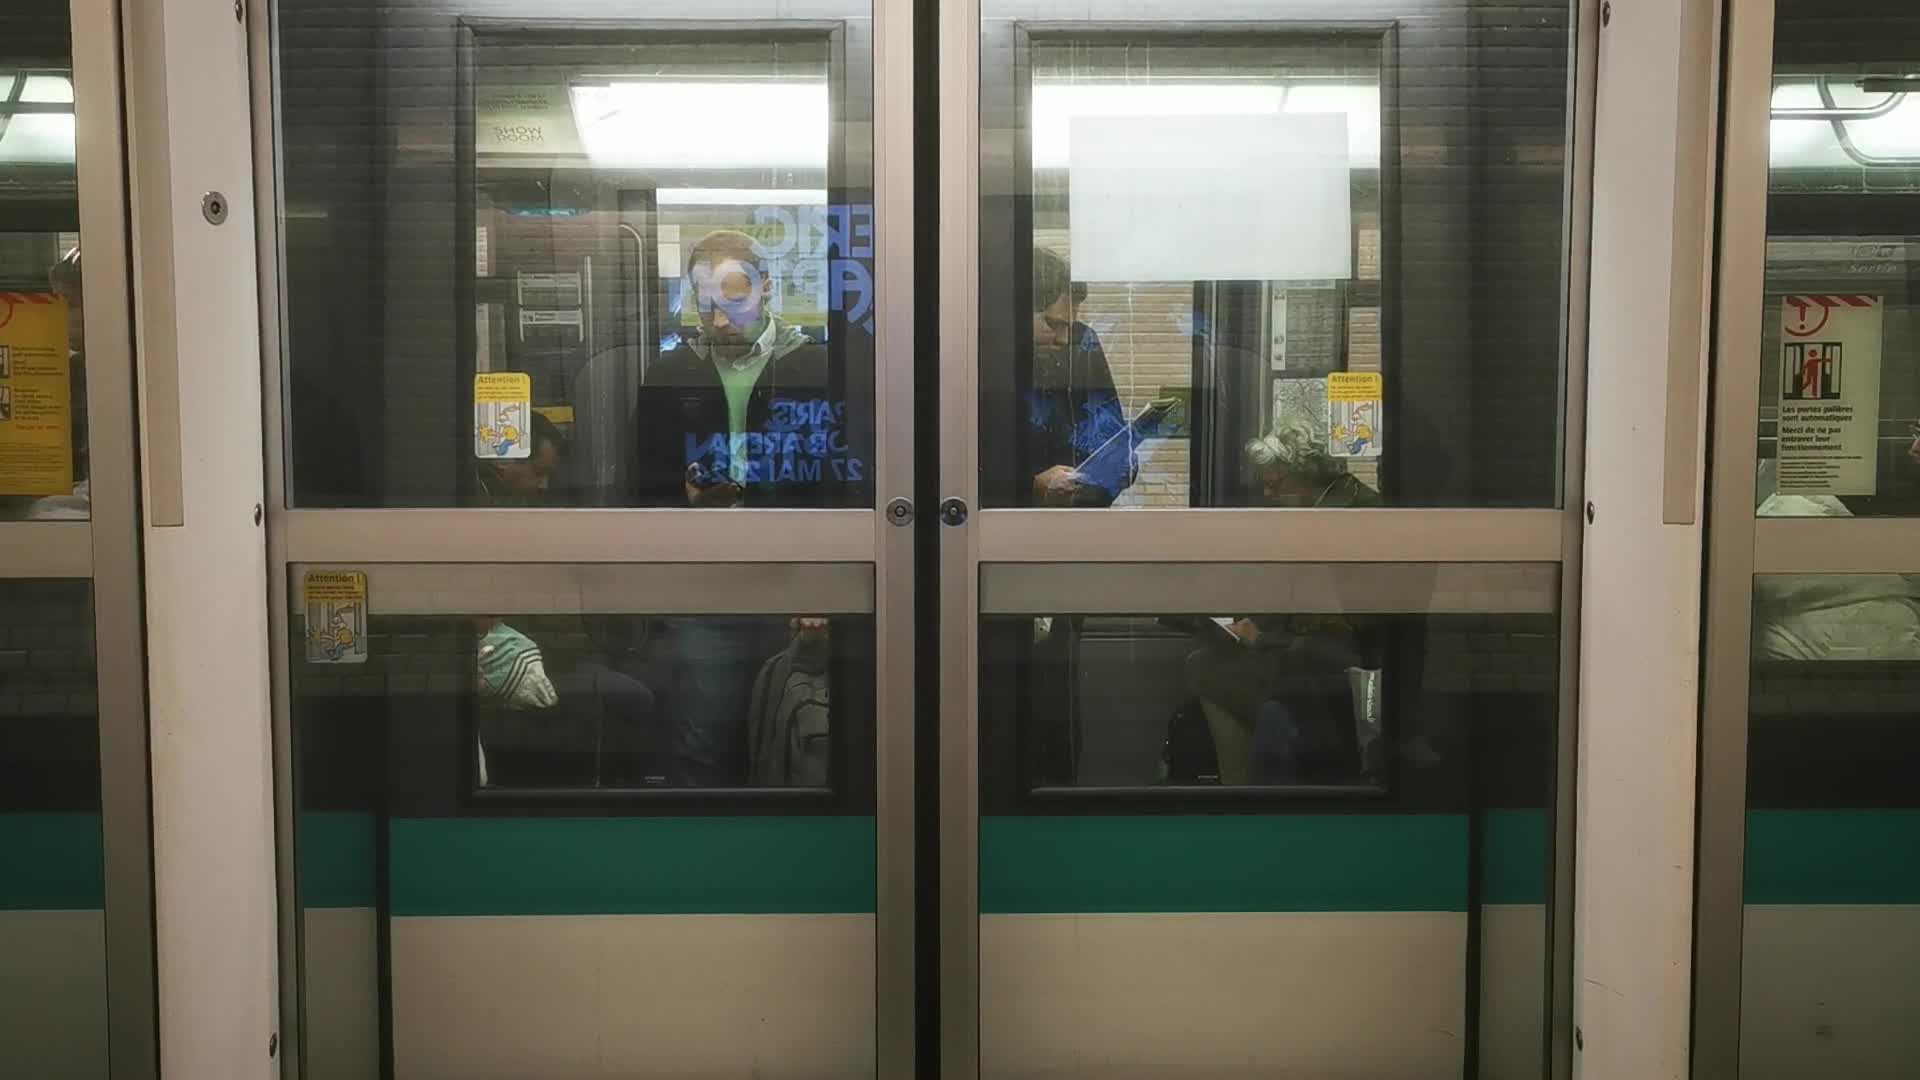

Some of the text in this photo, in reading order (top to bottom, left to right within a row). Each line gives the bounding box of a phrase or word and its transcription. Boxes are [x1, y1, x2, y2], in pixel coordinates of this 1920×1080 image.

[479, 376, 520, 384] Attention
[1332, 375, 1373, 383] Attention
[1797, 406, 1822, 414] portes
[308, 575, 354, 583] Attention
